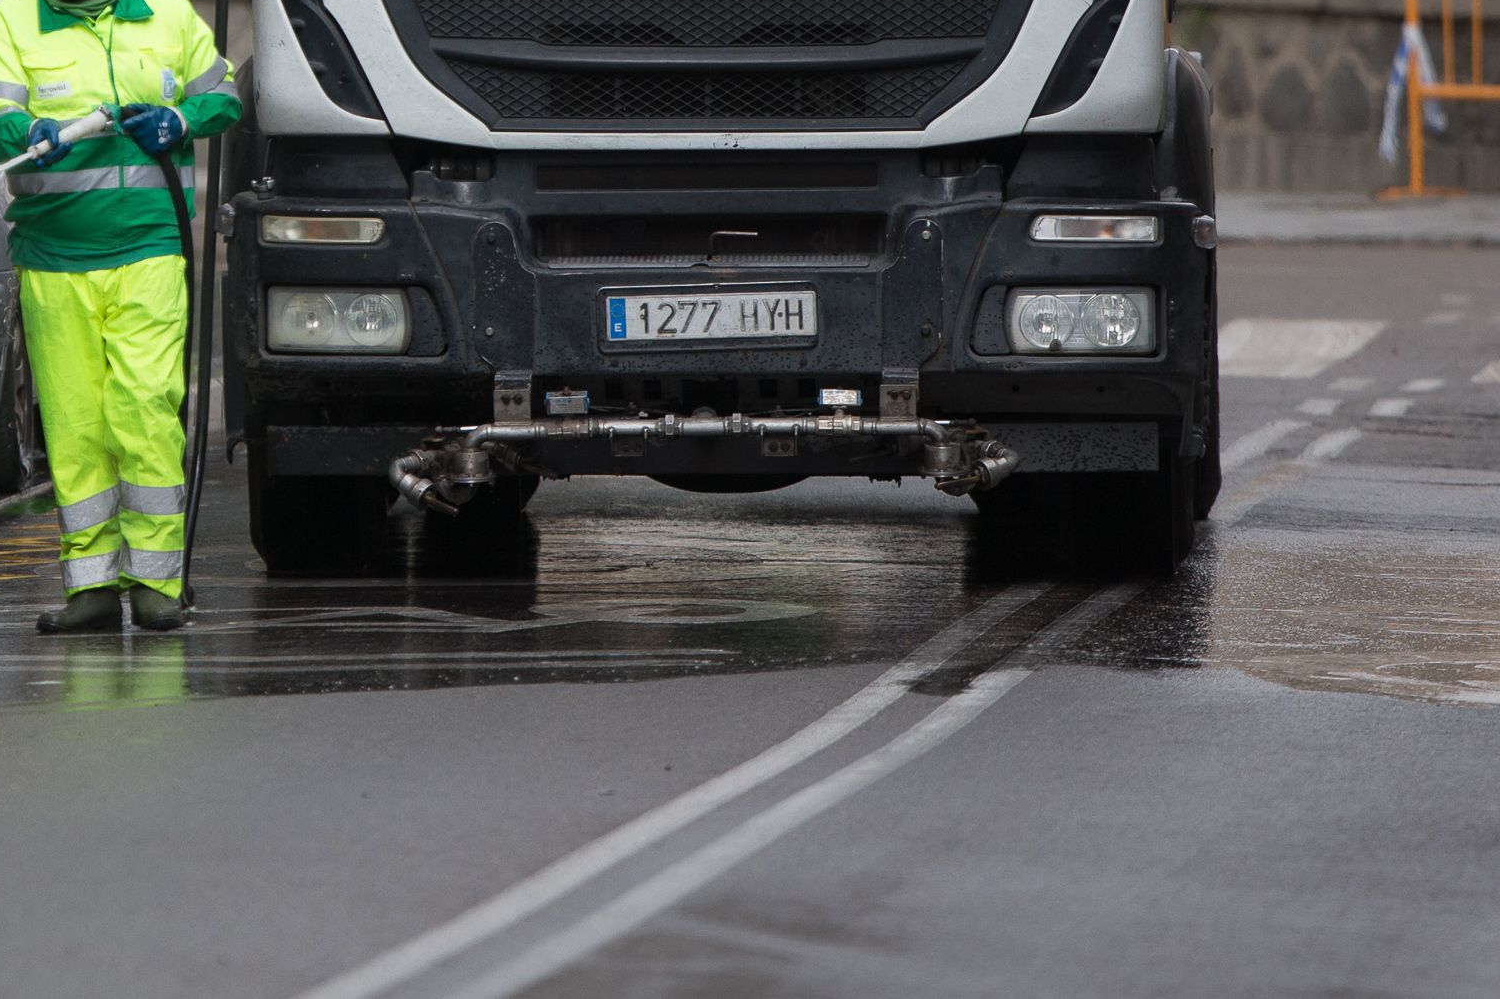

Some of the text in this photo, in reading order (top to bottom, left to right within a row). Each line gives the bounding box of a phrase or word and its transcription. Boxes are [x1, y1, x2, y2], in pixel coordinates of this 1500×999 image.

[614, 298, 804, 335] E 1277 HYH
